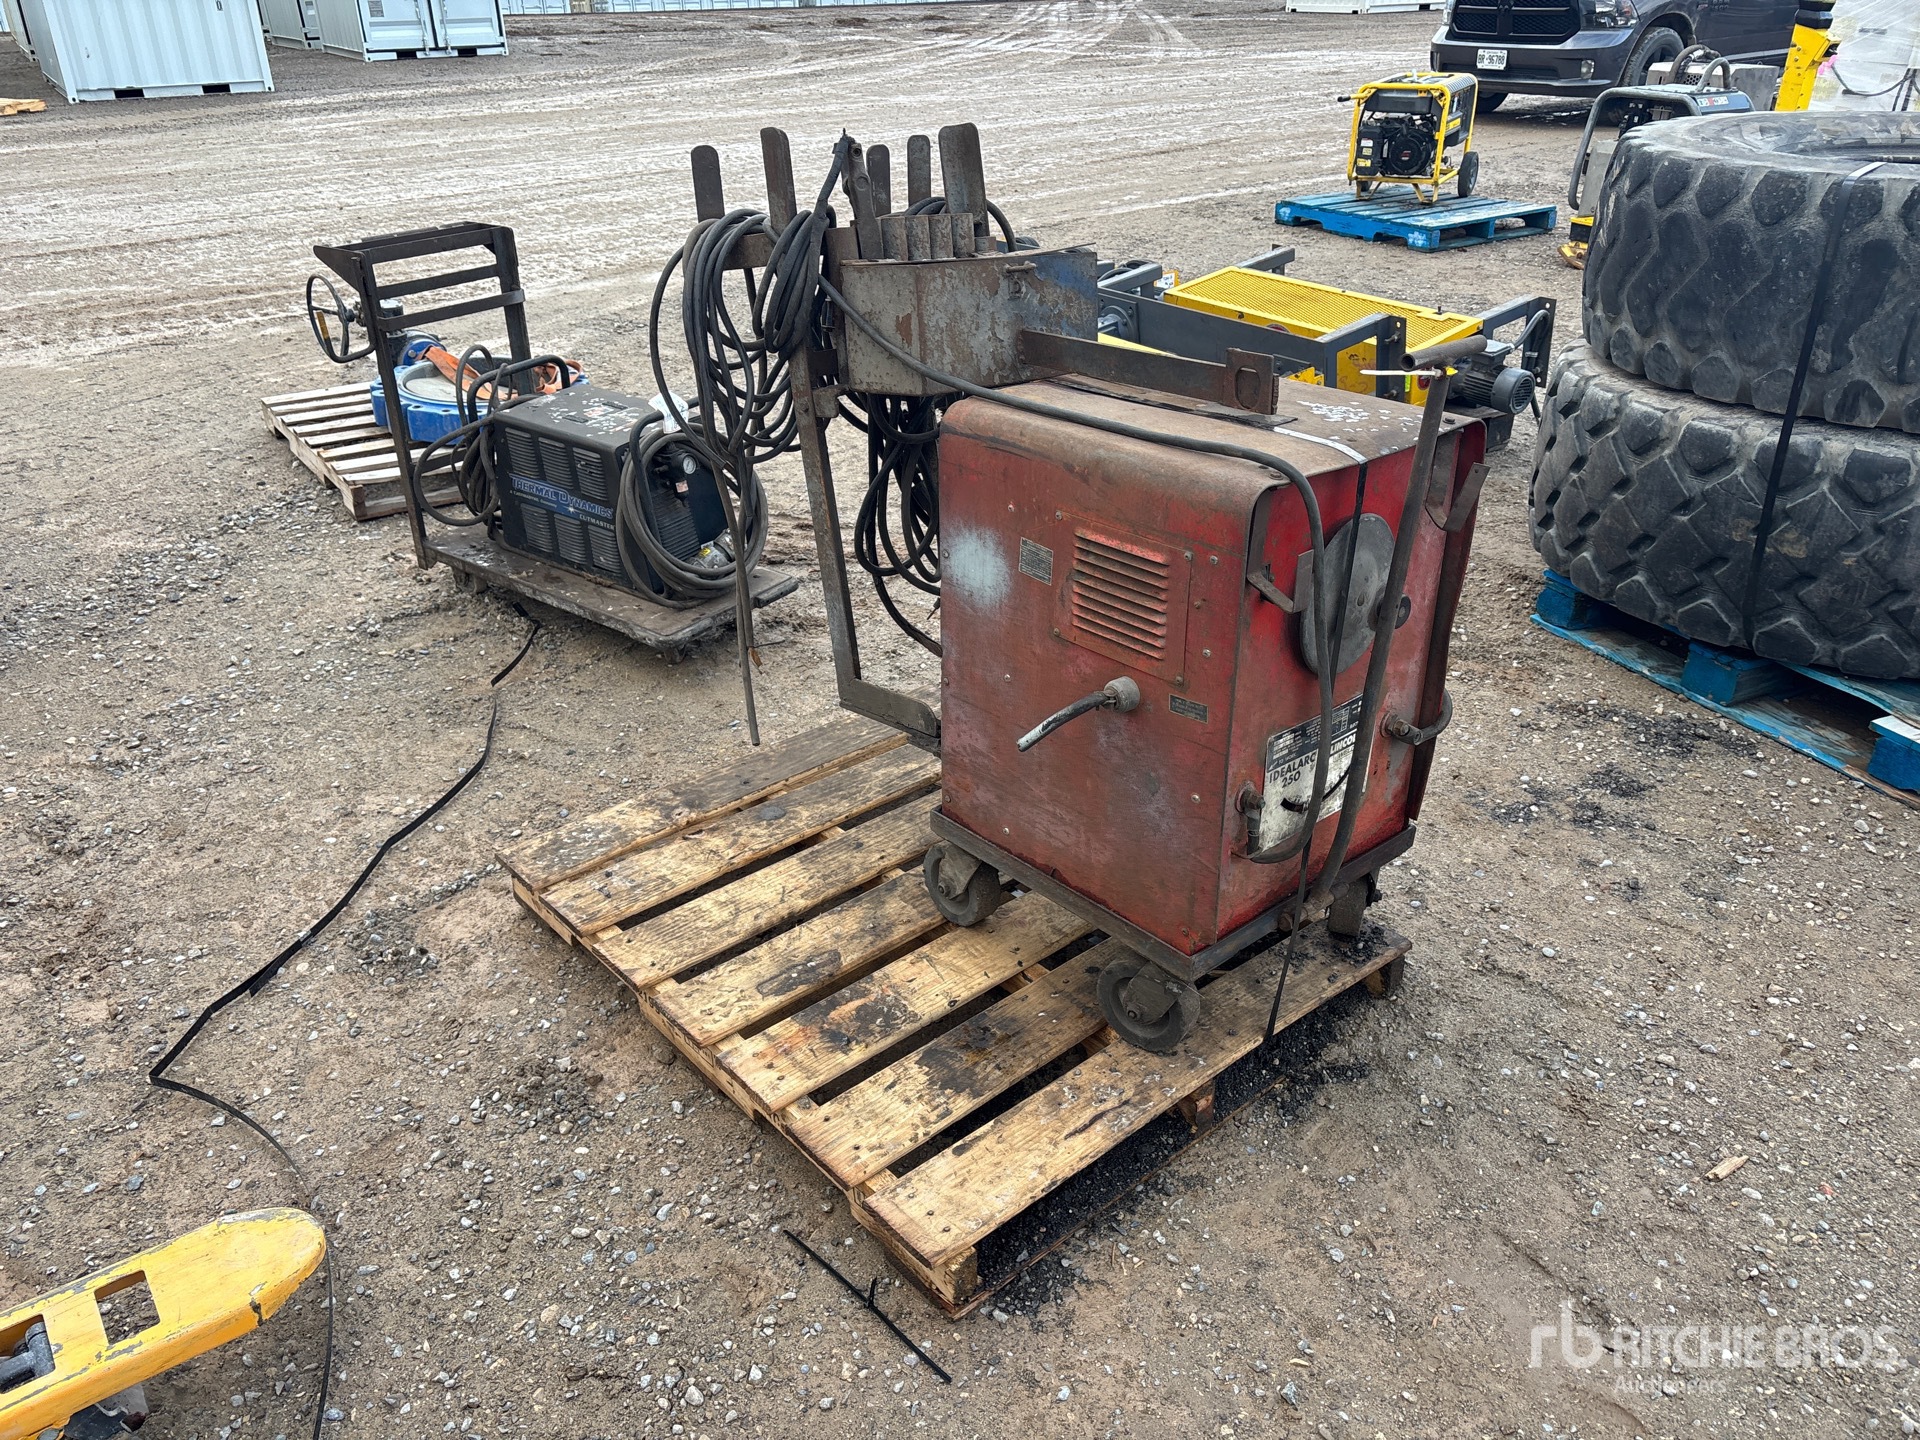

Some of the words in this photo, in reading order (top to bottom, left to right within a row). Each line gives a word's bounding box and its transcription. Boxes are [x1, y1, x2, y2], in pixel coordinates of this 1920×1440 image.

[511, 476, 557, 500] THERMAL
[558, 489, 613, 520] DYNAMICS
[580, 514, 615, 531] CUTMASTER
[1269, 752, 1317, 784] IDEALARC
[1282, 770, 1301, 788] 250
